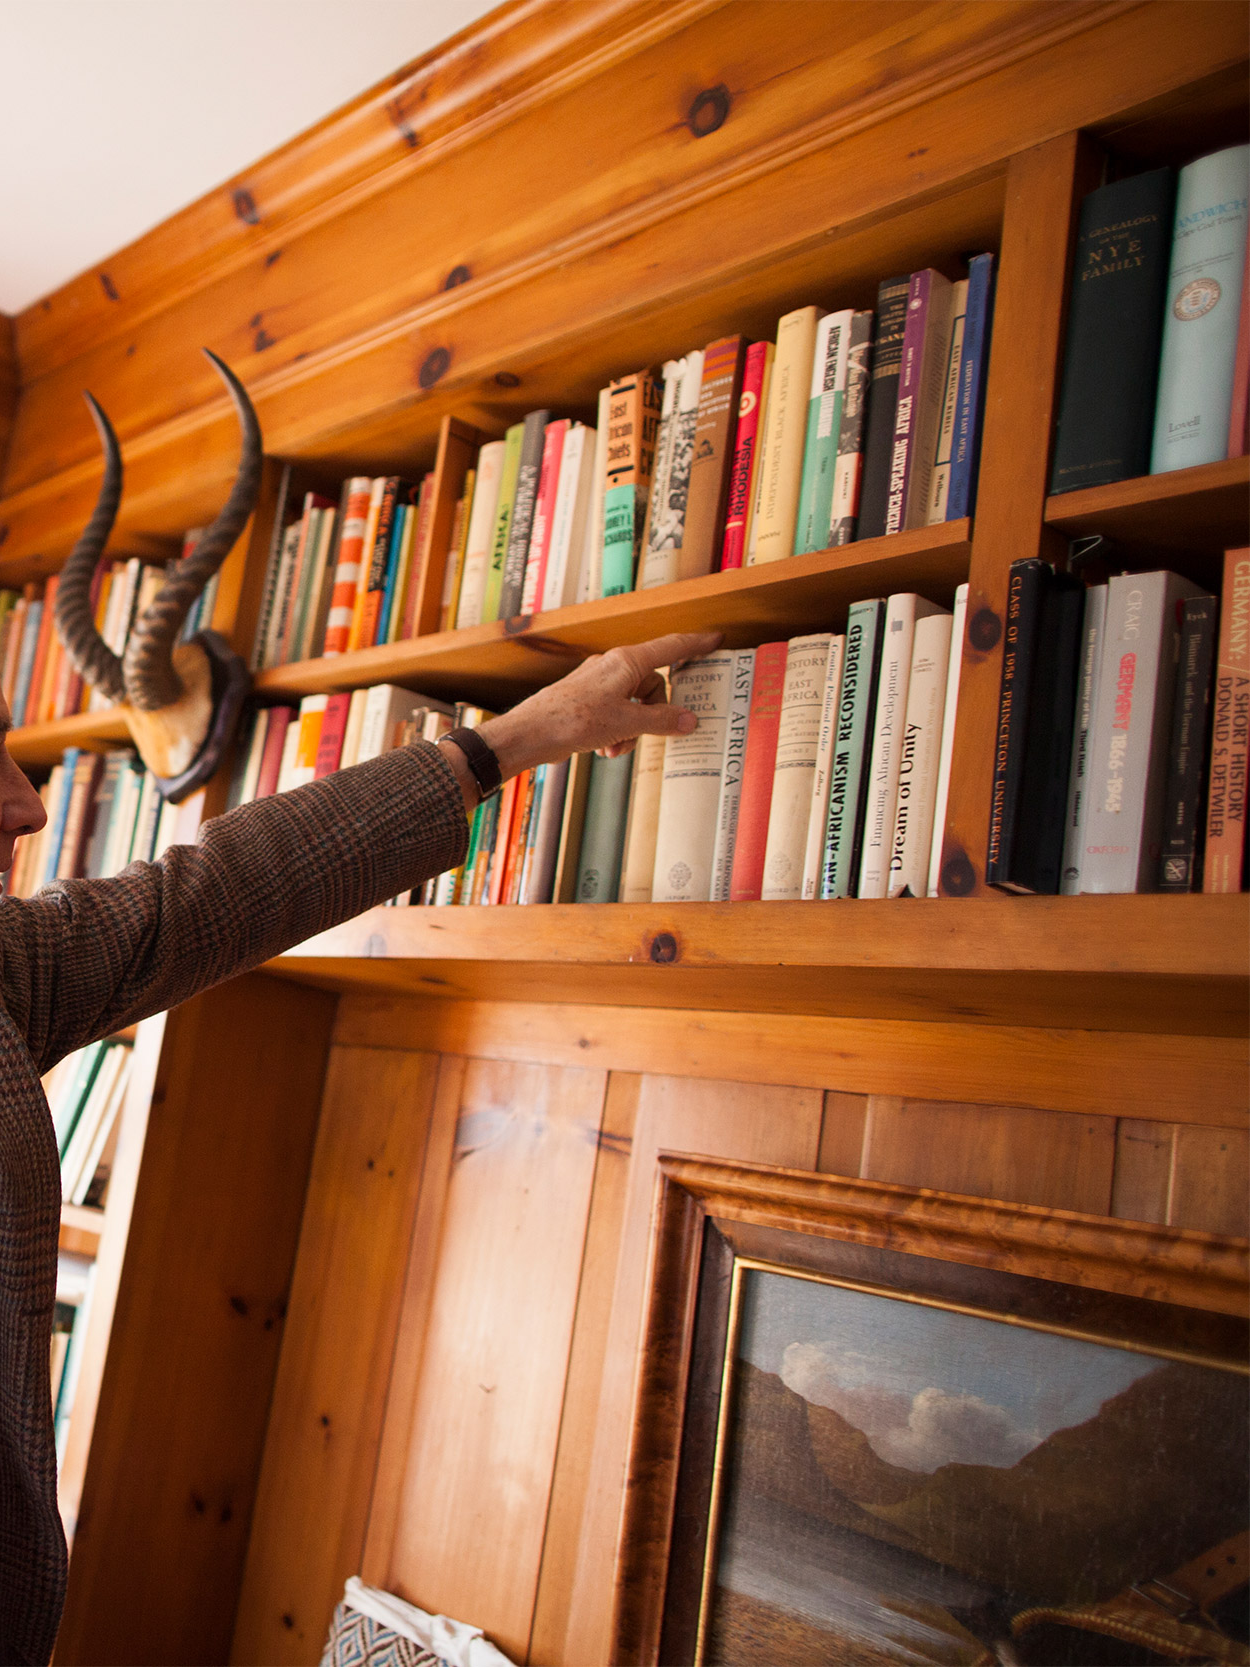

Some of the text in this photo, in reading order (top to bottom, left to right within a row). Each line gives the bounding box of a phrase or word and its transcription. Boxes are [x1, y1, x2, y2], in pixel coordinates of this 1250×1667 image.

[1089, 214, 1158, 238] GENEALOGY
[1178, 199, 1248, 228] ANDWICH
[1088, 239, 1143, 265] NYE
[1113, 231, 1131, 240] THE
[1082, 256, 1146, 281] FAMILY
[822, 325, 841, 392] AFRICAN ENGLISH
[780, 365, 791, 402] AFRICA
[943, 345, 960, 435] EAST AFRICAN REBELS
[775, 406, 786, 443] BLACK
[895, 395, 913, 435] AFRICA
[957, 359, 974, 463] FEDERATION IN EAST AFRICA
[1168, 415, 1200, 433] Lovell
[734, 436, 753, 517] RHODESIA
[765, 445, 782, 520] INDEPENDENT
[885, 438, 909, 536] FRENCH-SPEAKING
[1122, 590, 1144, 640] CRAIG
[1186, 611, 1209, 621] Eyck
[1229, 560, 1250, 662] GERMANY:
[1187, 634, 1202, 678] Bismarck
[677, 673, 724, 685] HISTORY
[684, 692, 711, 703] EAST
[788, 679, 814, 690] EAST
[821, 644, 839, 752] Creating Political Order
[838, 624, 863, 741] RECONSIDERED
[1111, 652, 1137, 731] GERMANY
[1185, 681, 1195, 695] and
[725, 655, 753, 787] EAST AFRICA
[989, 576, 1023, 865] CLASS OF 1958 PRINCETON UNIVERSITY
[1077, 628, 1097, 778] the foreign policy of the Third Reich
[1184, 698, 1193, 711] the
[1180, 712, 1193, 744] German
[1227, 676, 1250, 822] A SHORT HISTORY
[870, 660, 899, 847] Financing African Development
[1105, 734, 1127, 813] 1866-1945
[1209, 676, 1233, 838] DONALD S. DETWILER
[815, 769, 824, 796] Zolberg
[890, 723, 922, 871] Dream of Unity
[721, 794, 730, 830] RECORDS
[728, 795, 739, 834] THROUGH
[1087, 846, 1130, 854] OXFORD
